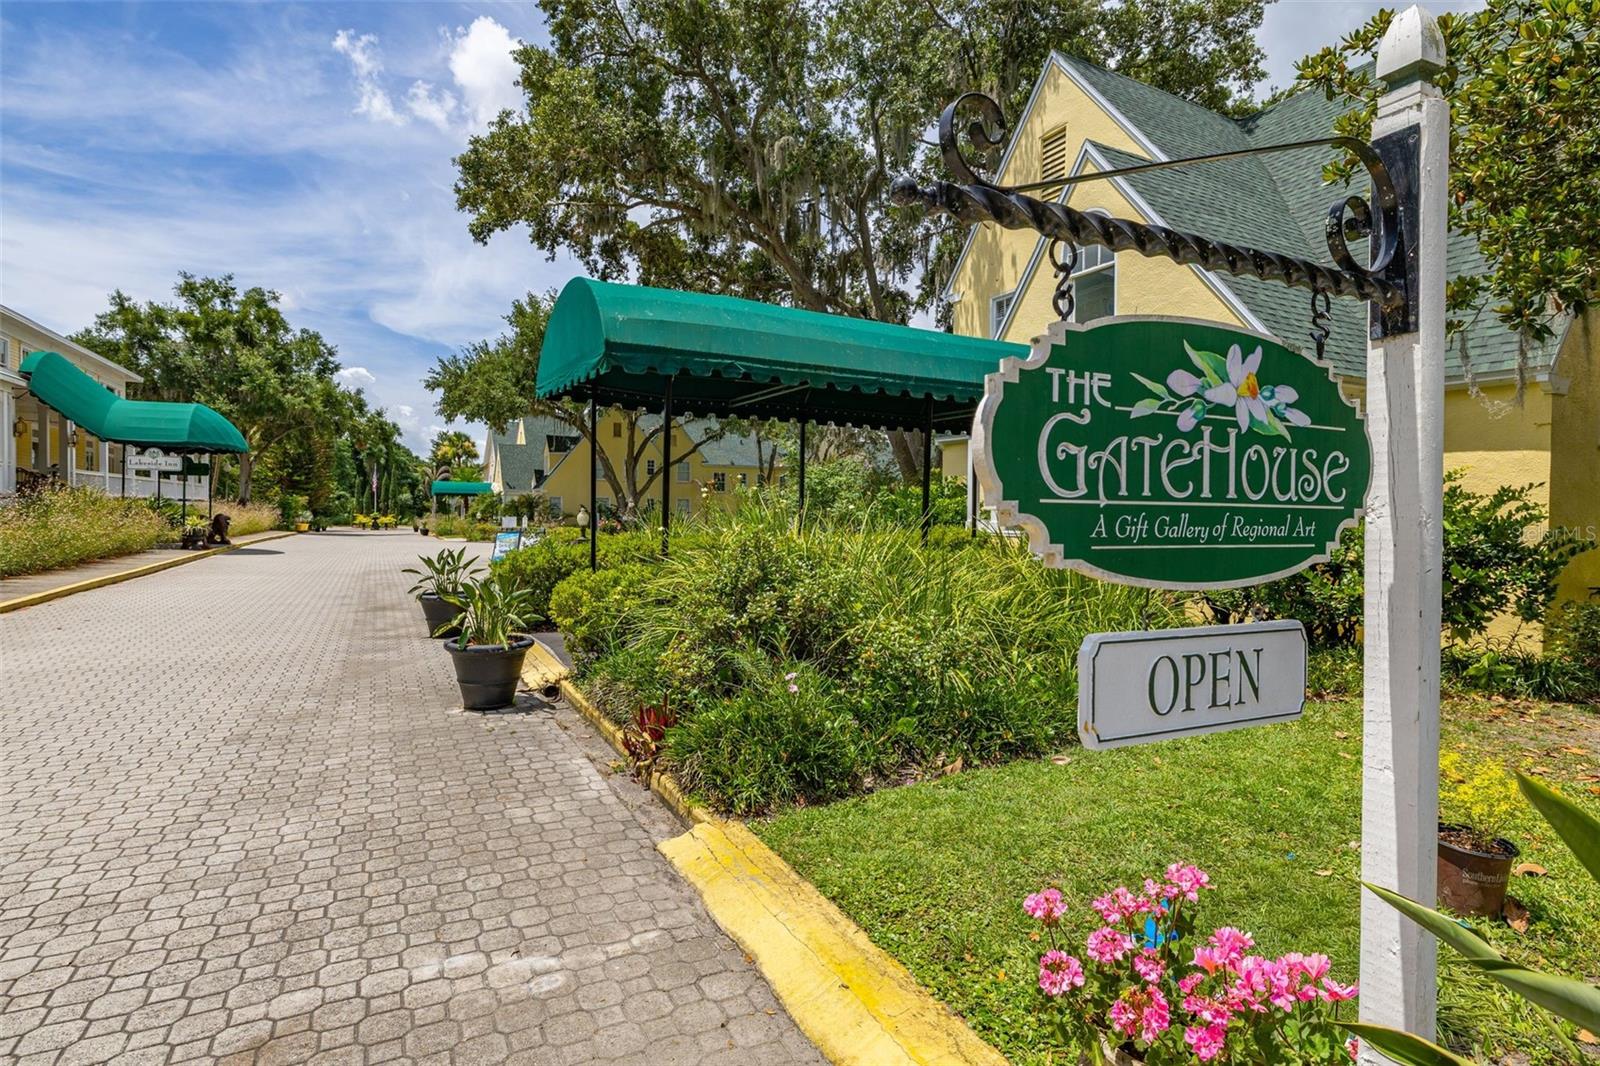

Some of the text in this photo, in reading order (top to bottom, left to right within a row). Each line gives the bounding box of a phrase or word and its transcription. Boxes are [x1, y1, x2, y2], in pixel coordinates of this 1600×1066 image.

[1046, 367, 1112, 408] THE
[129, 458, 162, 467] Lakeside
[1089, 512, 1316, 543] A Gift Gallery of Regional Art
[1148, 646, 1264, 716] OPEN
